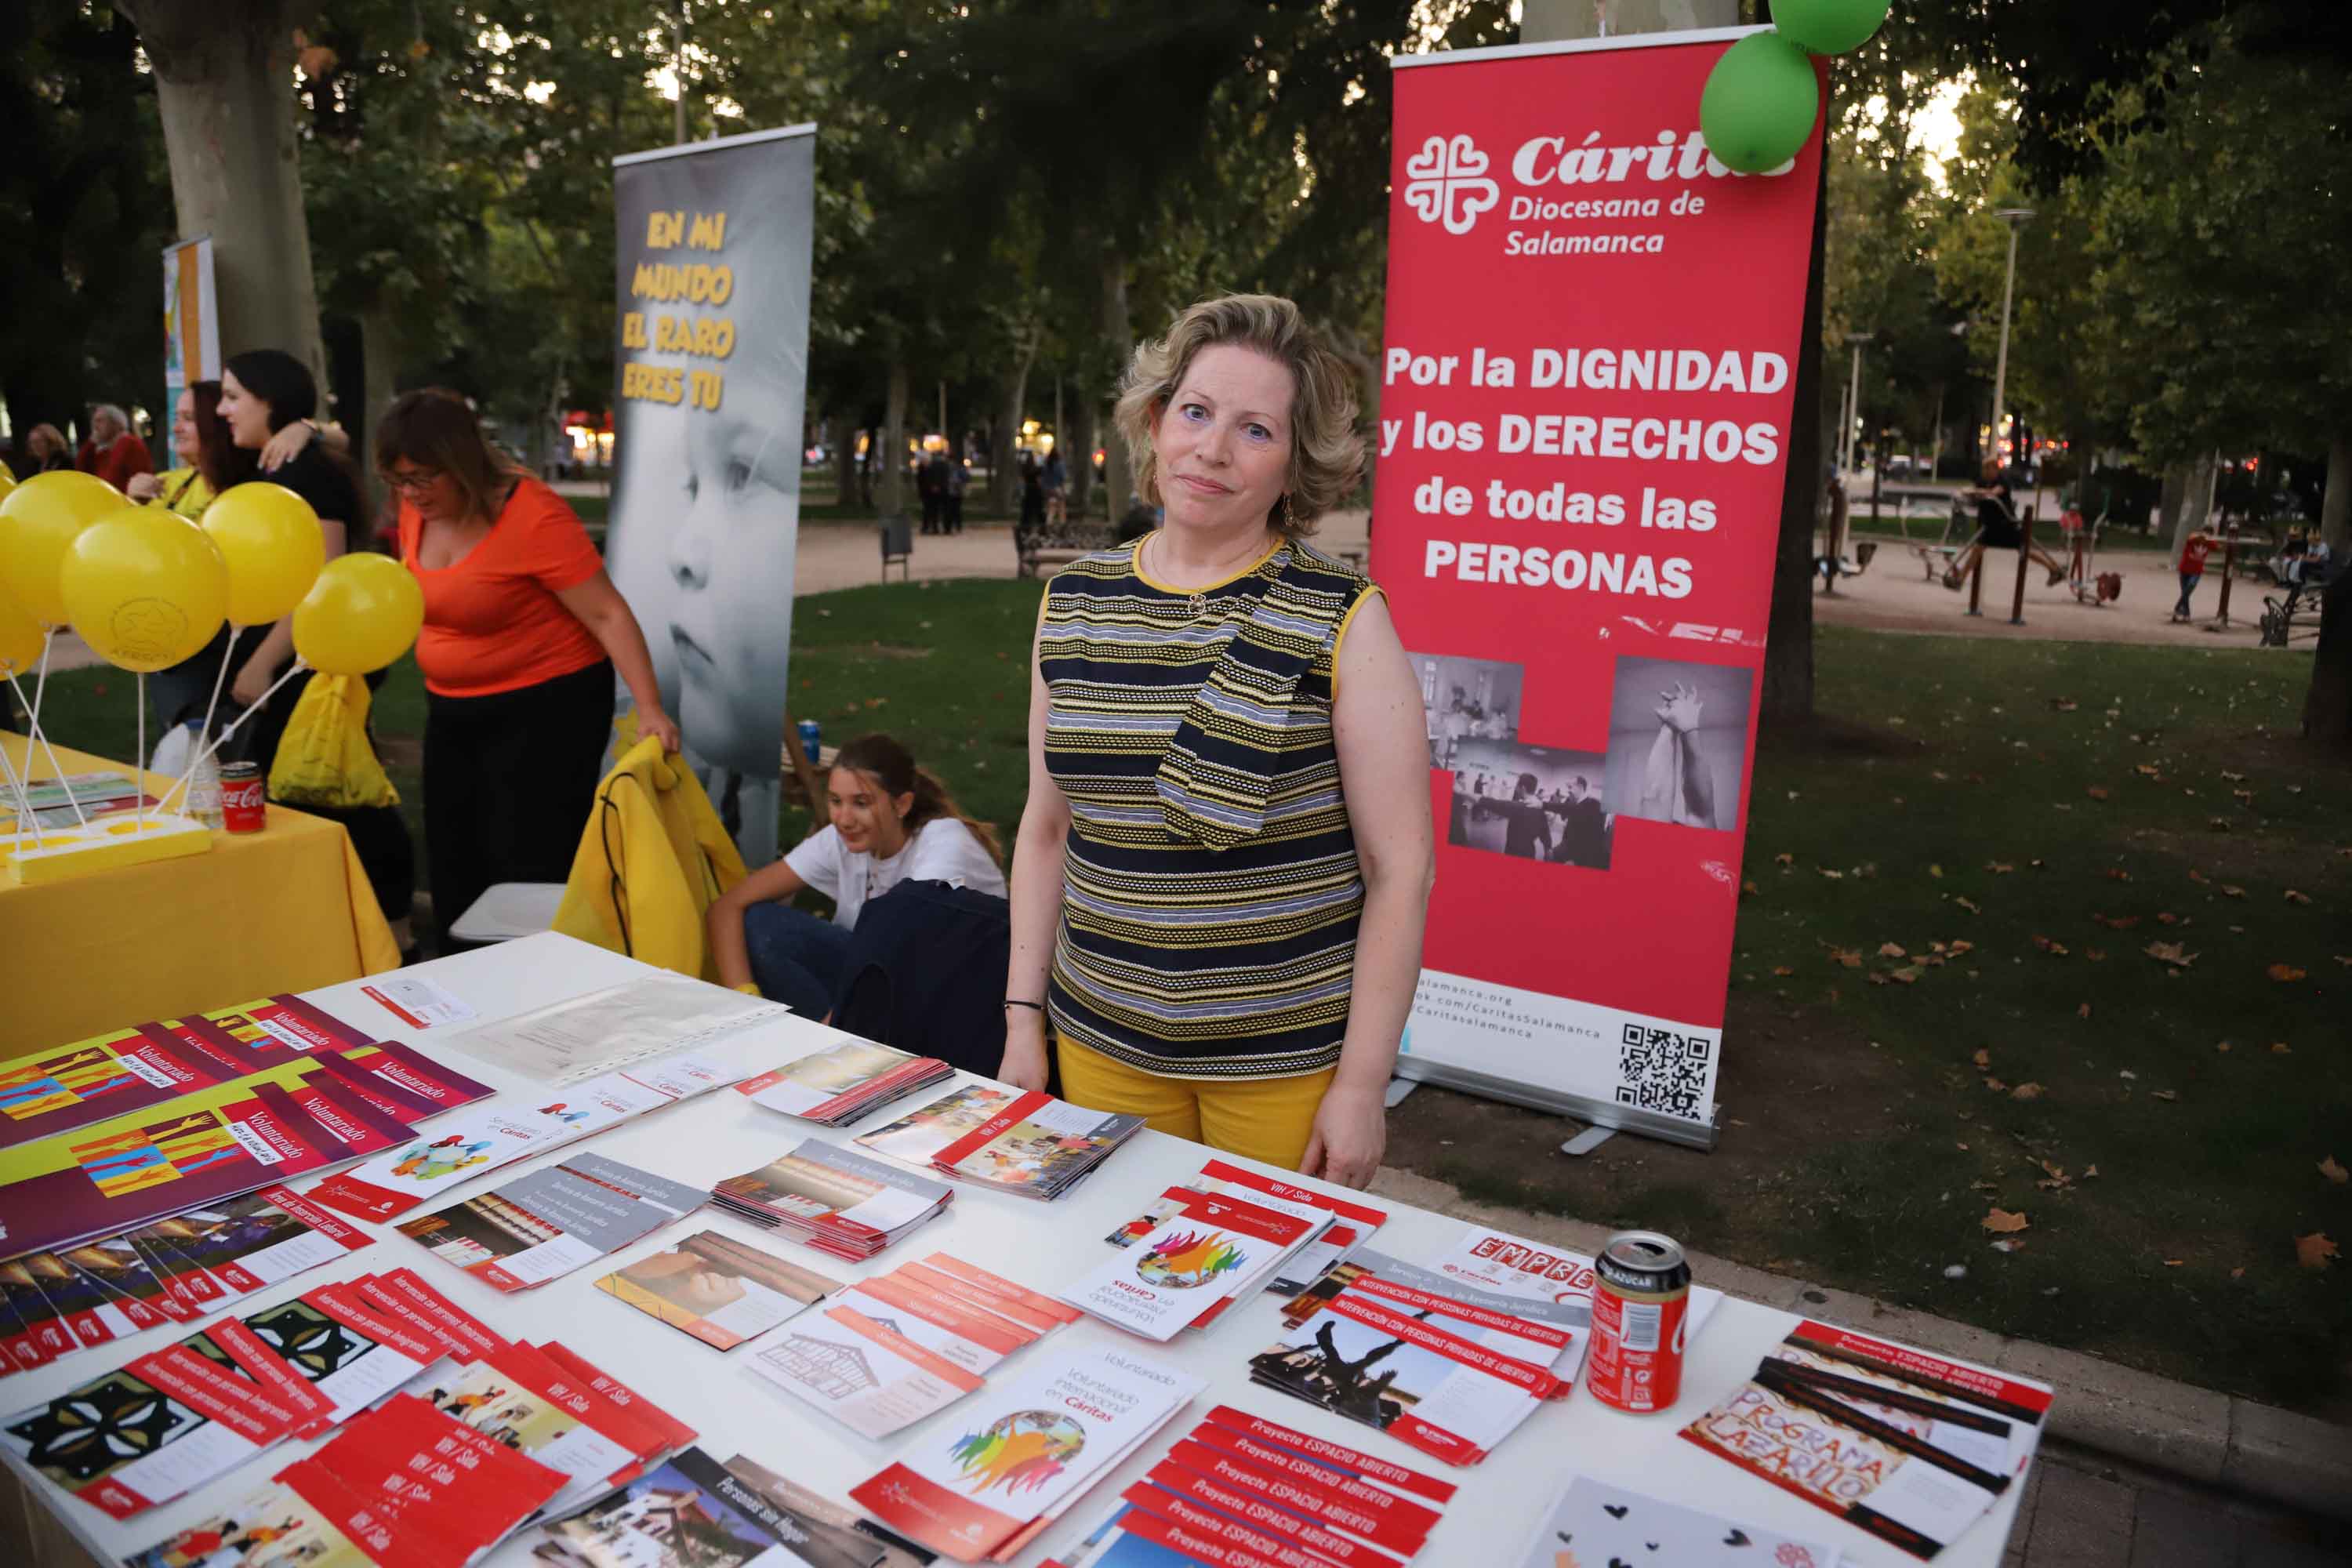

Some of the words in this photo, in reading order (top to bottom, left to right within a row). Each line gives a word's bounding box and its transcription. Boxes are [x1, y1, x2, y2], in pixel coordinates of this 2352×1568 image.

[1509, 195, 1661, 221] Diocesana
[1669, 190, 1706, 216] de
[647, 211, 684, 249] EN
[689, 212, 726, 251] MI
[1504, 230, 1664, 256] Salamanca
[631, 263, 733, 305] MUNDO
[622, 310, 648, 350] EL
[655, 316, 735, 359] RARO
[622, 362, 683, 405] ERES
[1385, 347, 1459, 387] Por
[1472, 347, 1515, 387] la
[1530, 348, 1788, 394] DIGNIDAD
[1381, 419, 1402, 457] y
[1413, 412, 1483, 452] los
[1498, 413, 1780, 465] DERECHOS
[1414, 476, 1473, 516] de
[1486, 479, 1625, 526] todas
[1640, 487, 1717, 532] las
[1424, 539, 1693, 599] PERSONAS
[274, 1011, 330, 1047] Voluntariado
[1415, 1004, 1531, 1039] Caritasalamanca
[136, 1045, 195, 1083] Voluntariado
[379, 1061, 446, 1099] Voluntariado
[248, 1111, 305, 1160] Voluntariado
[303, 1097, 366, 1142] Voluntariado
[1270, 1182, 1286, 1194] VIH
[1284, 1186, 1294, 1196] /
[1294, 1191, 1313, 1203] Sida
[1474, 1236, 1594, 1288] EMPRE
[1359, 1278, 1412, 1301] INTERVENCIÓN
[1411, 1293, 1429, 1306] CON
[1429, 1297, 1471, 1318] PERSONAS
[1470, 1308, 1510, 1329] PRIVADAS
[1510, 1319, 1523, 1332] DE
[1522, 1323, 1563, 1344] LIBERTAD
[1336, 1299, 1387, 1325] INTERVENCIÓN
[1385, 1316, 1404, 1332] CON
[1403, 1323, 1446, 1348] PERSONAS
[1443, 1341, 1485, 1363] PRIVADAS
[1484, 1355, 1497, 1369] DE
[1495, 1359, 1537, 1385] LIBERTAD
[1251, 1420, 1301, 1446] Proyecto
[1305, 1436, 1357, 1466] ESPACIO
[1356, 1454, 1410, 1483] ABIERTO
[1726, 1388, 1882, 1485] PROGRAMA
[1214, 1461, 1268, 1490] Proyecto
[1269, 1479, 1323, 1512] ESPACIO
[1321, 1501, 1377, 1534] ABIERTO
[1236, 1438, 1286, 1466] Proyecto
[1288, 1457, 1341, 1488] ESPACIO
[1339, 1479, 1393, 1509] ABIERTO
[717, 1476, 764, 1514] Personas
[758, 1508, 779, 1526] sin
[1192, 1479, 1246, 1512] Proyecto
[1246, 1502, 1301, 1534] ESPACIO
[1298, 1526, 1355, 1558] ABIERTO
[1166, 1526, 1225, 1560] Proyecto
[1167, 1500, 1222, 1532] Proyecto
[1221, 1524, 1279, 1556] ESPACIO
